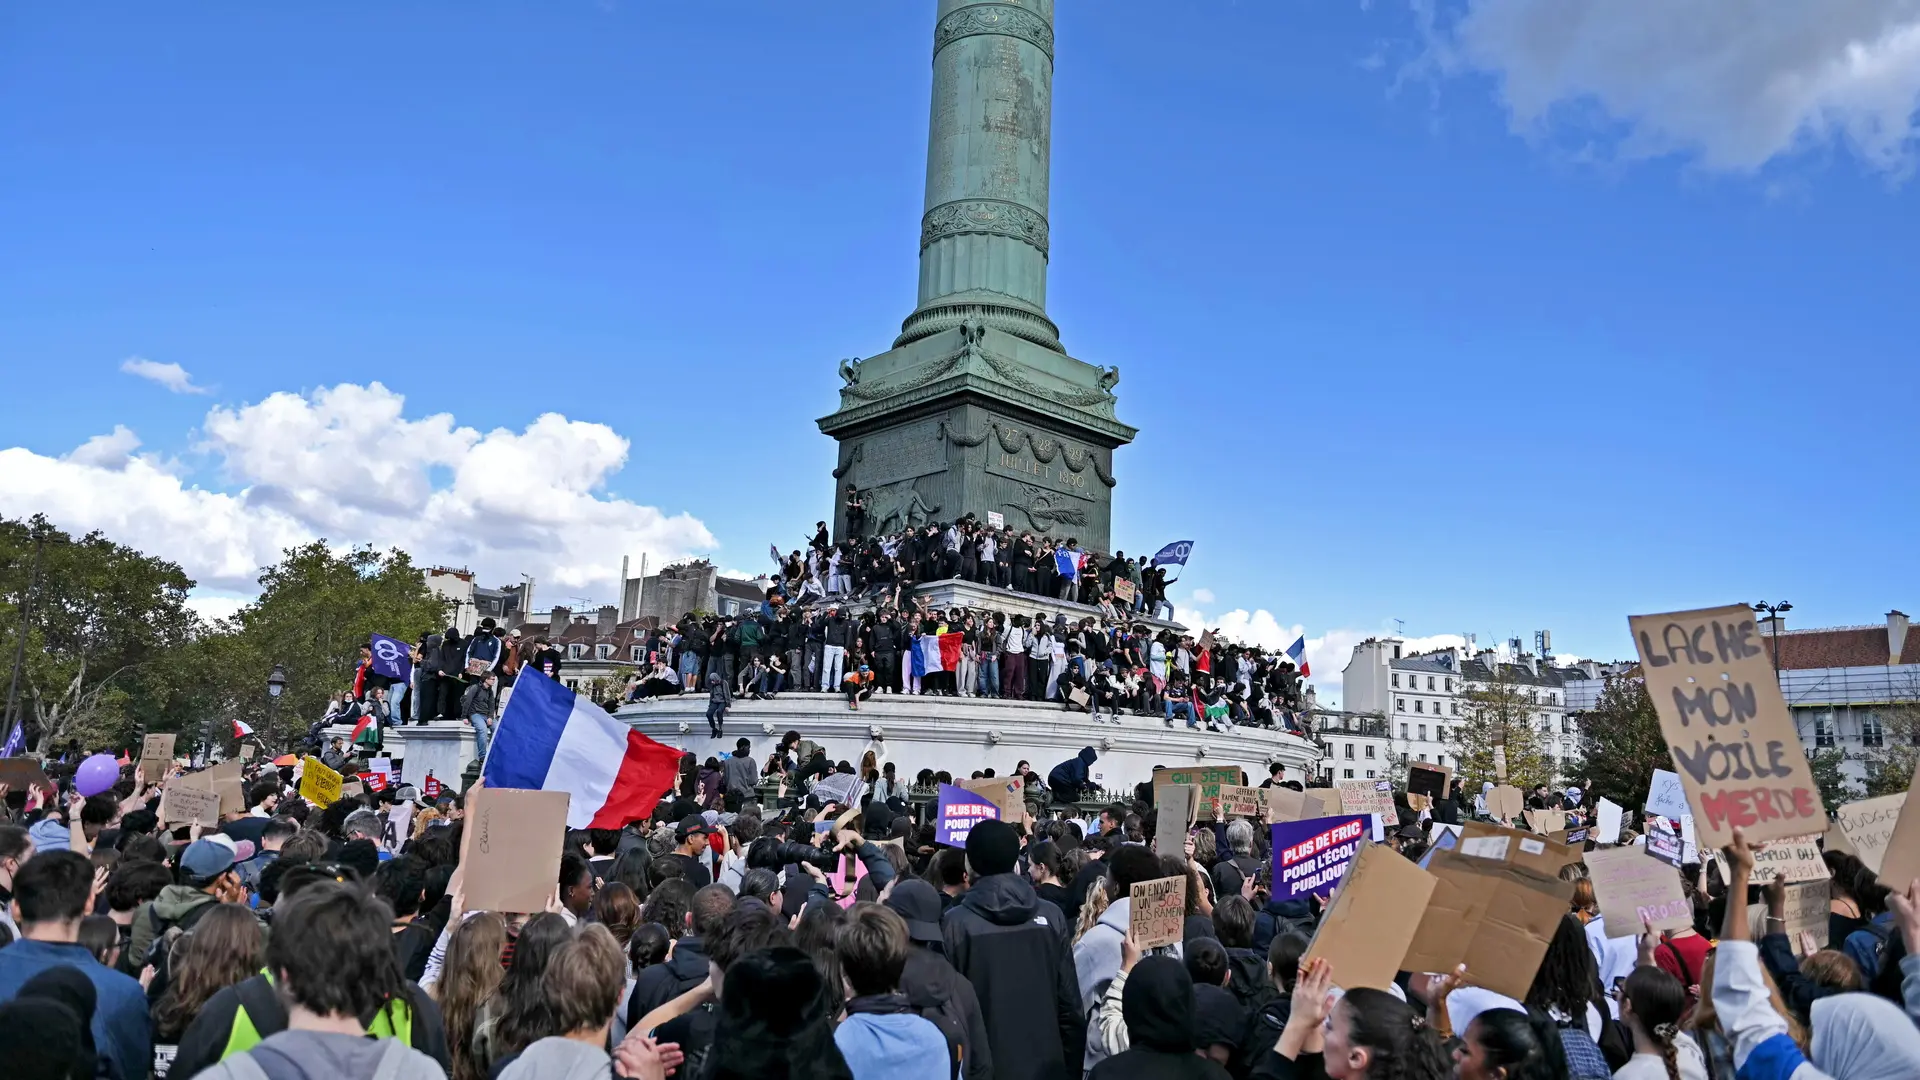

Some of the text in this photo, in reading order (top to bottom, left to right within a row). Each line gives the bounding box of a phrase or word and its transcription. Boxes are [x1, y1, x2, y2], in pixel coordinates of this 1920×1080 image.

[1038, 438, 1051, 451] 28
[999, 453, 1084, 488] JUILLET 1830
[1672, 682, 1757, 728] MON
[1673, 740, 1792, 785] VOILE
[1172, 768, 1237, 785] QUI SÈME
[946, 805, 996, 818] PLUS DE FRIC
[1700, 787, 1816, 832] MERDE
[945, 819, 970, 830] POUR
[1283, 822, 1361, 865] PLUS DE FRIC
[1754, 848, 1792, 862] EMPLOI
[1796, 848, 1815, 861] DU
[1283, 858, 1316, 882] POUR
[1134, 879, 1179, 898] ON ENVOIE
[1138, 894, 1182, 910] UN SOS
[1133, 909, 1153, 922] ILS
[1152, 918, 1180, 936] CRS
